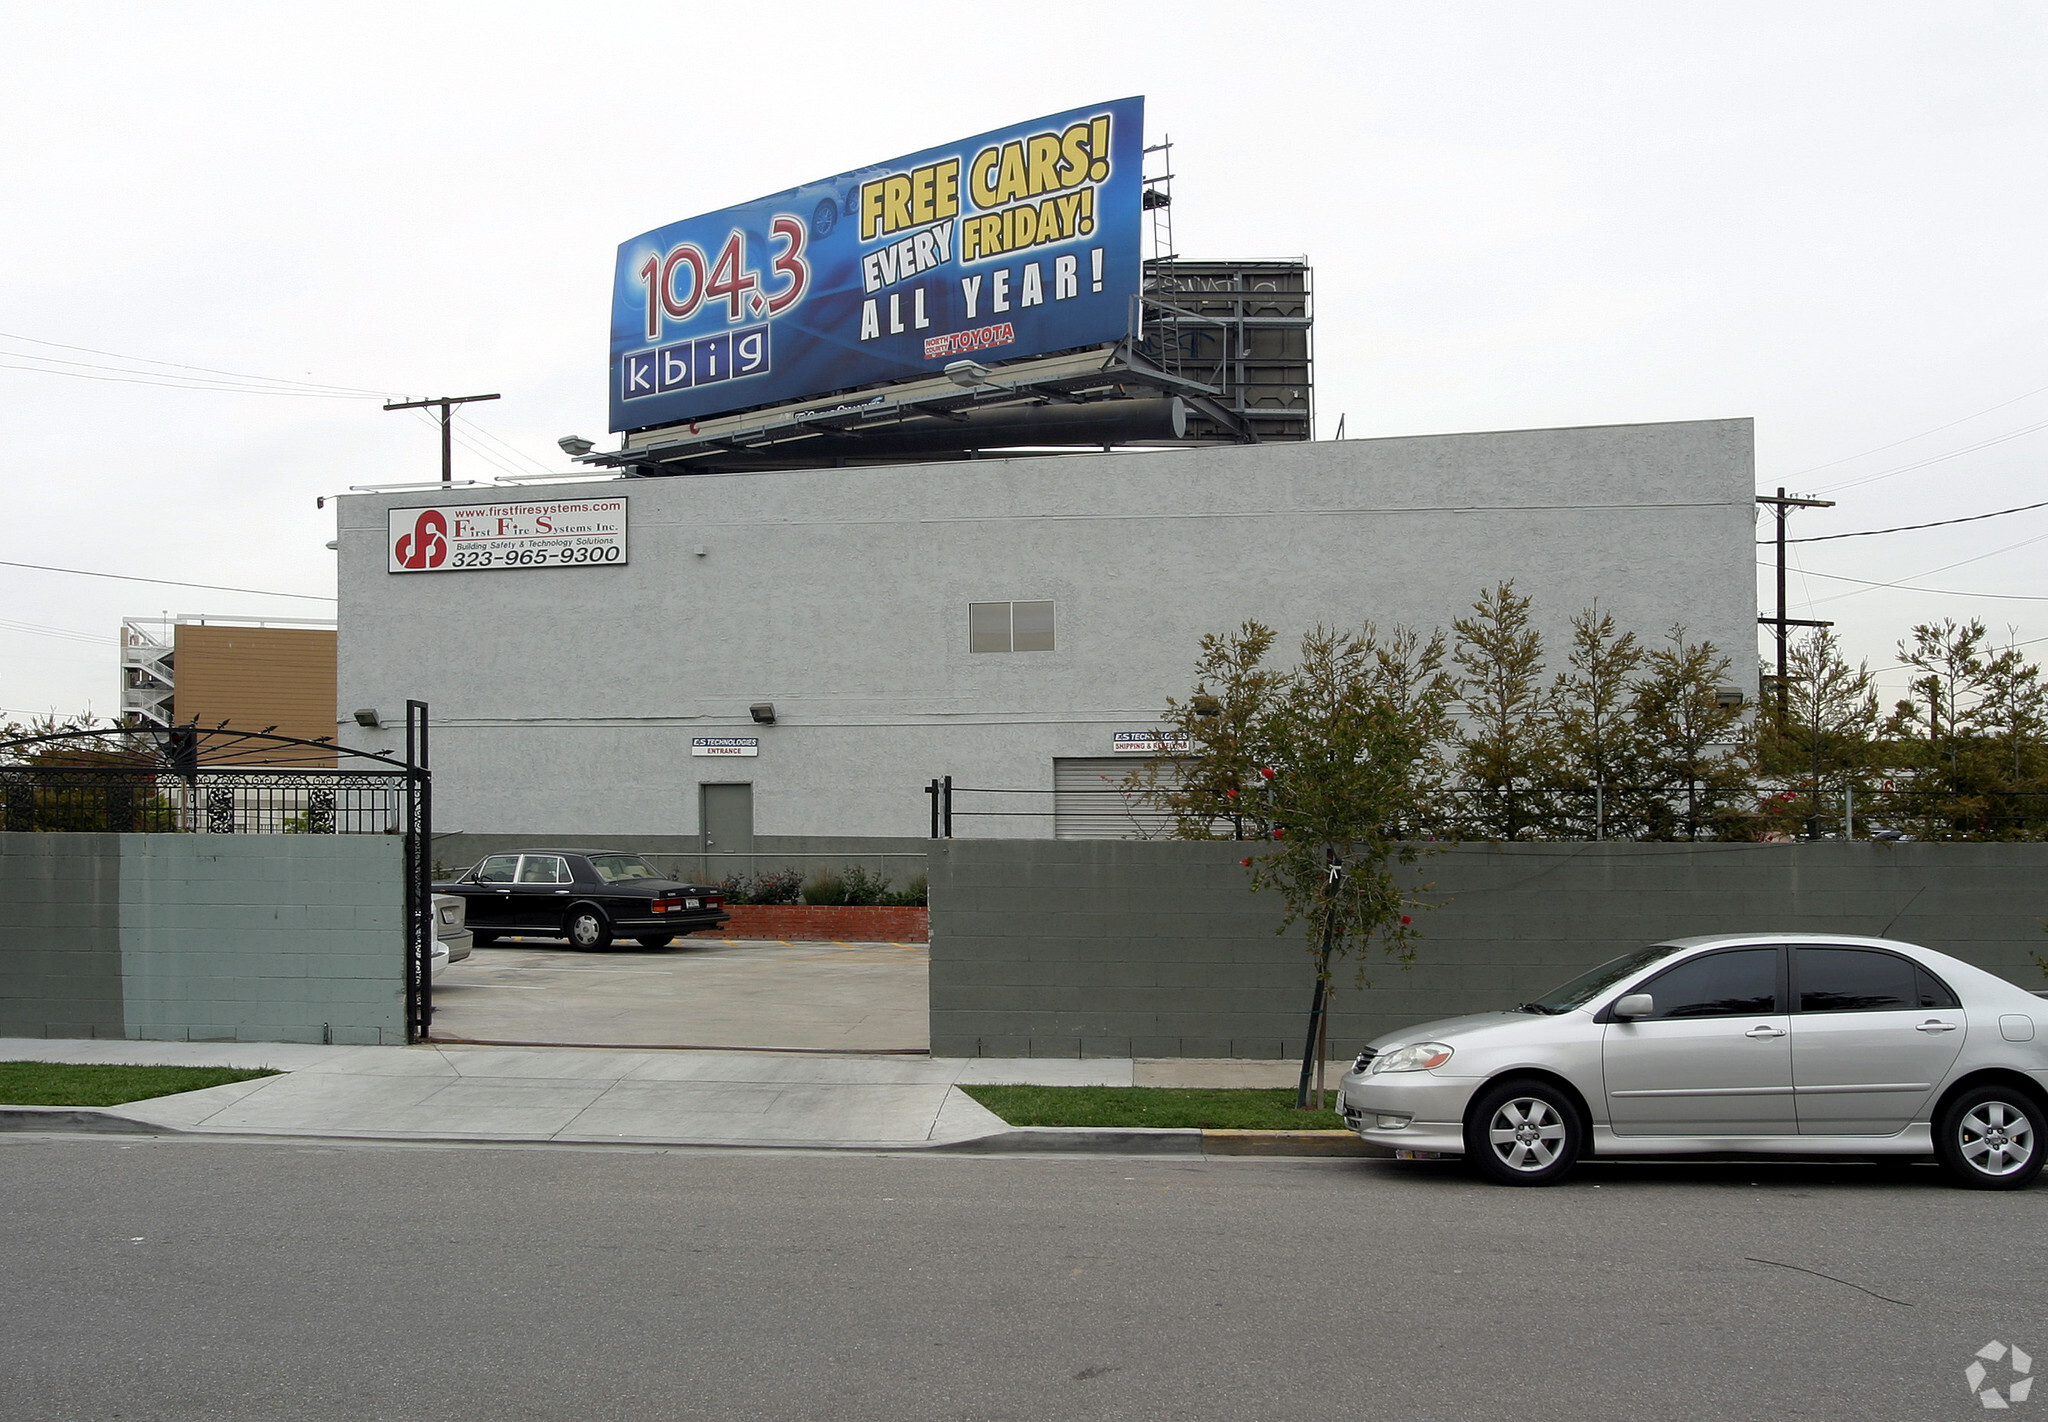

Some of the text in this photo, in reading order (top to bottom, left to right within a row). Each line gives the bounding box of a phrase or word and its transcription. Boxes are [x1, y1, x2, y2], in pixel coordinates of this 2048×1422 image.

[861, 114, 1110, 240] FREE CARS!
[862, 186, 1094, 294] EVERY FRIDAY!
[640, 215, 808, 340] 104.3
[860, 287, 930, 341] ALL
[961, 248, 1105, 320] YEAR!
[925, 335, 949, 347] NORTH
[949, 322, 1015, 349] TOYOTA
[629, 332, 763, 392] kbig
[454, 502, 621, 518] www.firstfiresystems.com
[452, 515, 619, 538] First Fire Systems Inc.
[451, 545, 621, 568] 323-965-9300
[456, 542, 488, 552] Building
[490, 541, 516, 550] Safety
[529, 538, 573, 548] Technology
[576, 537, 614, 546] Solutions
[1115, 742, 1146, 750] SHIPPING
